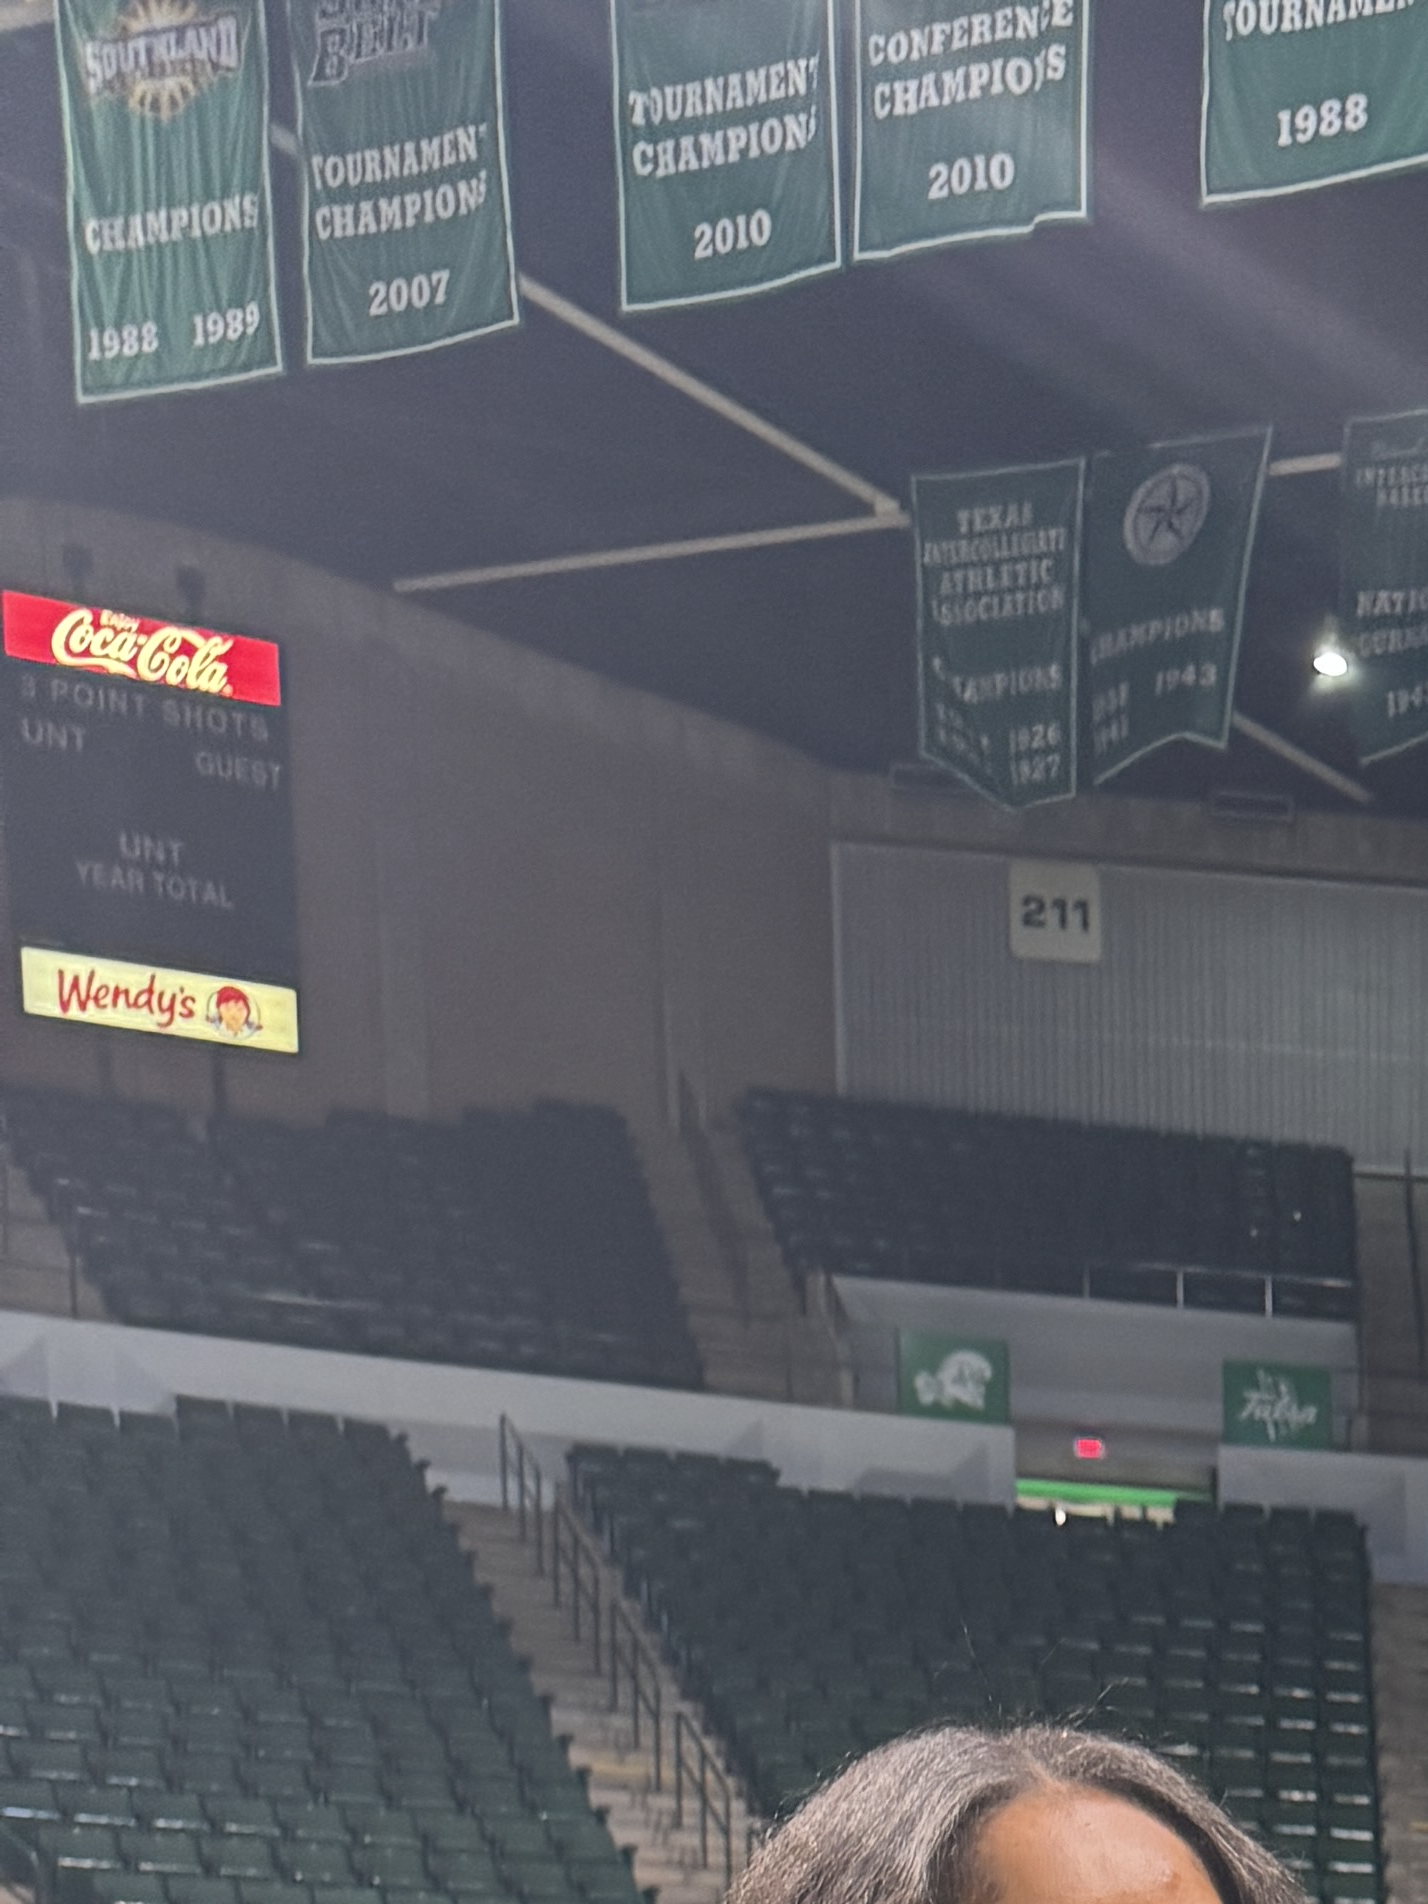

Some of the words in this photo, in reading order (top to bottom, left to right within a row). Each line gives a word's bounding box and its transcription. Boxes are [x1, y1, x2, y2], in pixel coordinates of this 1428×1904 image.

[1277, 93, 1369, 147] 1988
[312, 122, 487, 190] TOURNAMEN
[927, 153, 1015, 200] 2010
[84, 193, 258, 256] CHAMPIONS
[694, 209, 772, 259] 2010
[368, 269, 450, 317] 2007
[87, 321, 158, 361] 1988
[192, 301, 260, 347] 1989
[51, 608, 234, 697] Coca-Cola
[51, 679, 147, 715] POINT
[21, 716, 86, 750] UNT
[119, 829, 184, 867] UNT
[1021, 893, 1091, 933] 211
[57, 968, 197, 1029] Wendy's
